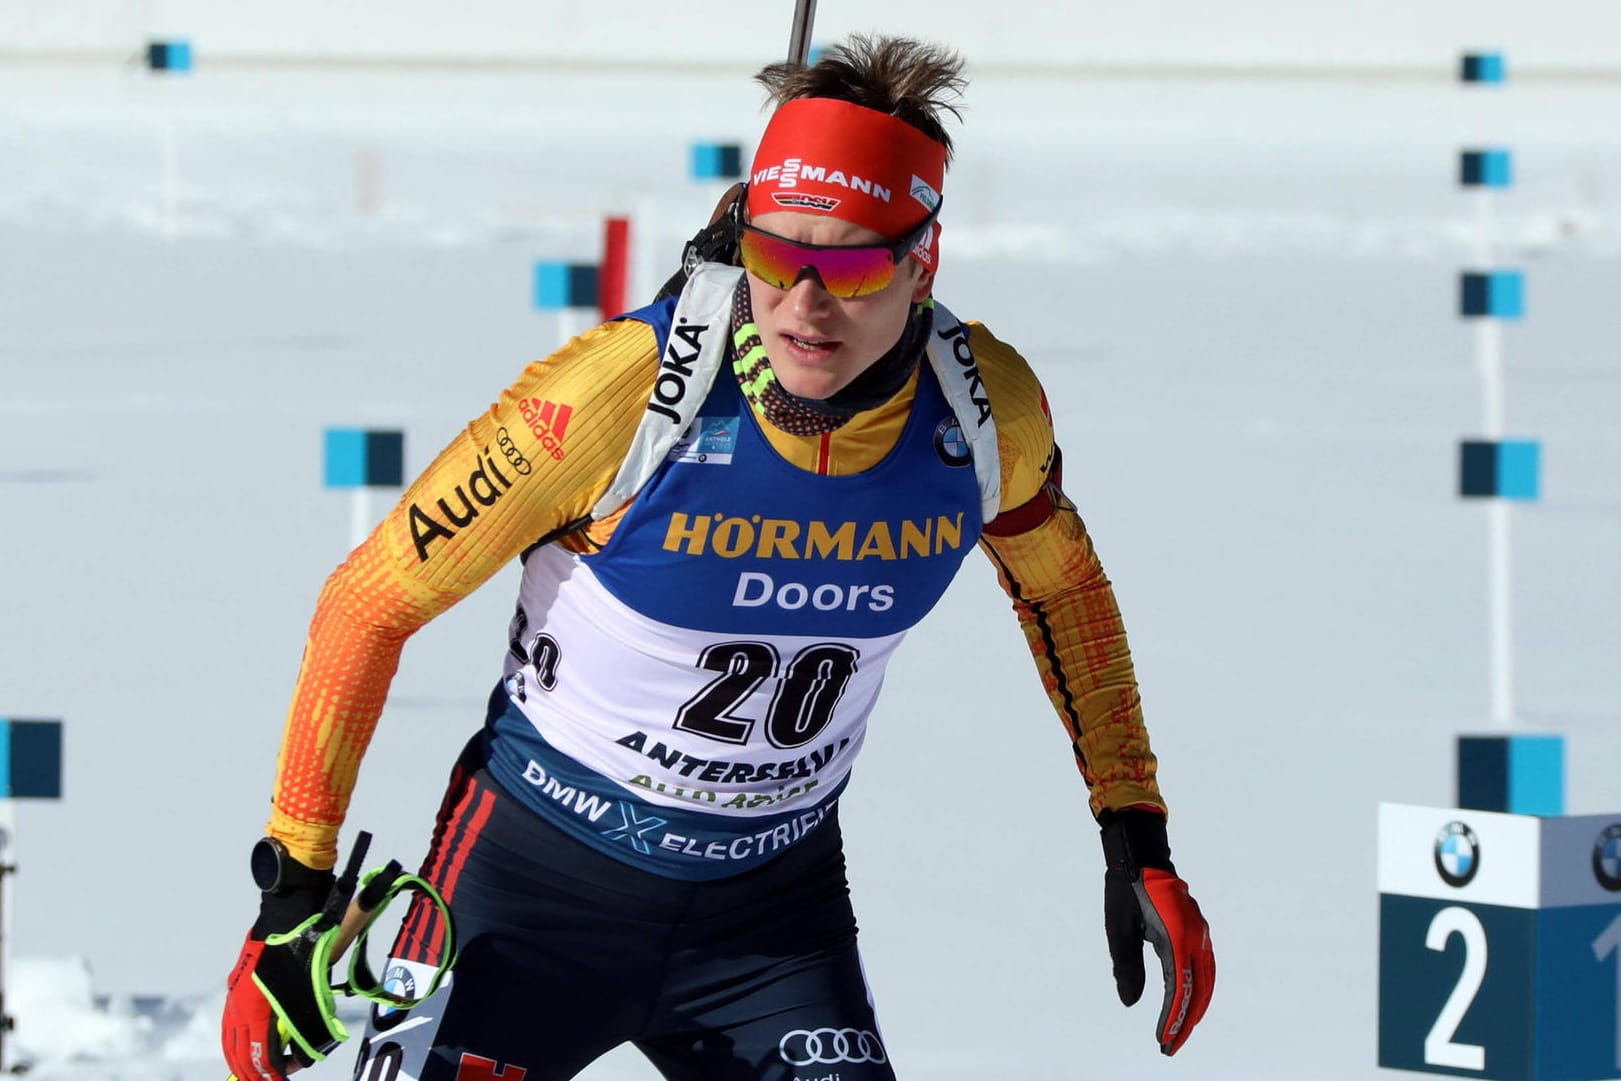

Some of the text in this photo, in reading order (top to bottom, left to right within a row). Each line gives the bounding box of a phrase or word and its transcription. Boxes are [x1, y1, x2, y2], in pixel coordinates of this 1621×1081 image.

[753, 158, 892, 203] VIESSMANN
[647, 317, 709, 425] JOKA
[937, 325, 992, 428] JOKA
[518, 398, 564, 461] adidas
[409, 445, 513, 564] Audi
[662, 512, 965, 561] HÖRMANN
[732, 572, 895, 612] Doors
[672, 640, 861, 750] 20
[521, 758, 612, 824] BMW
[658, 799, 838, 861] ELECTRIFI
[1424, 906, 1488, 1071] 2
